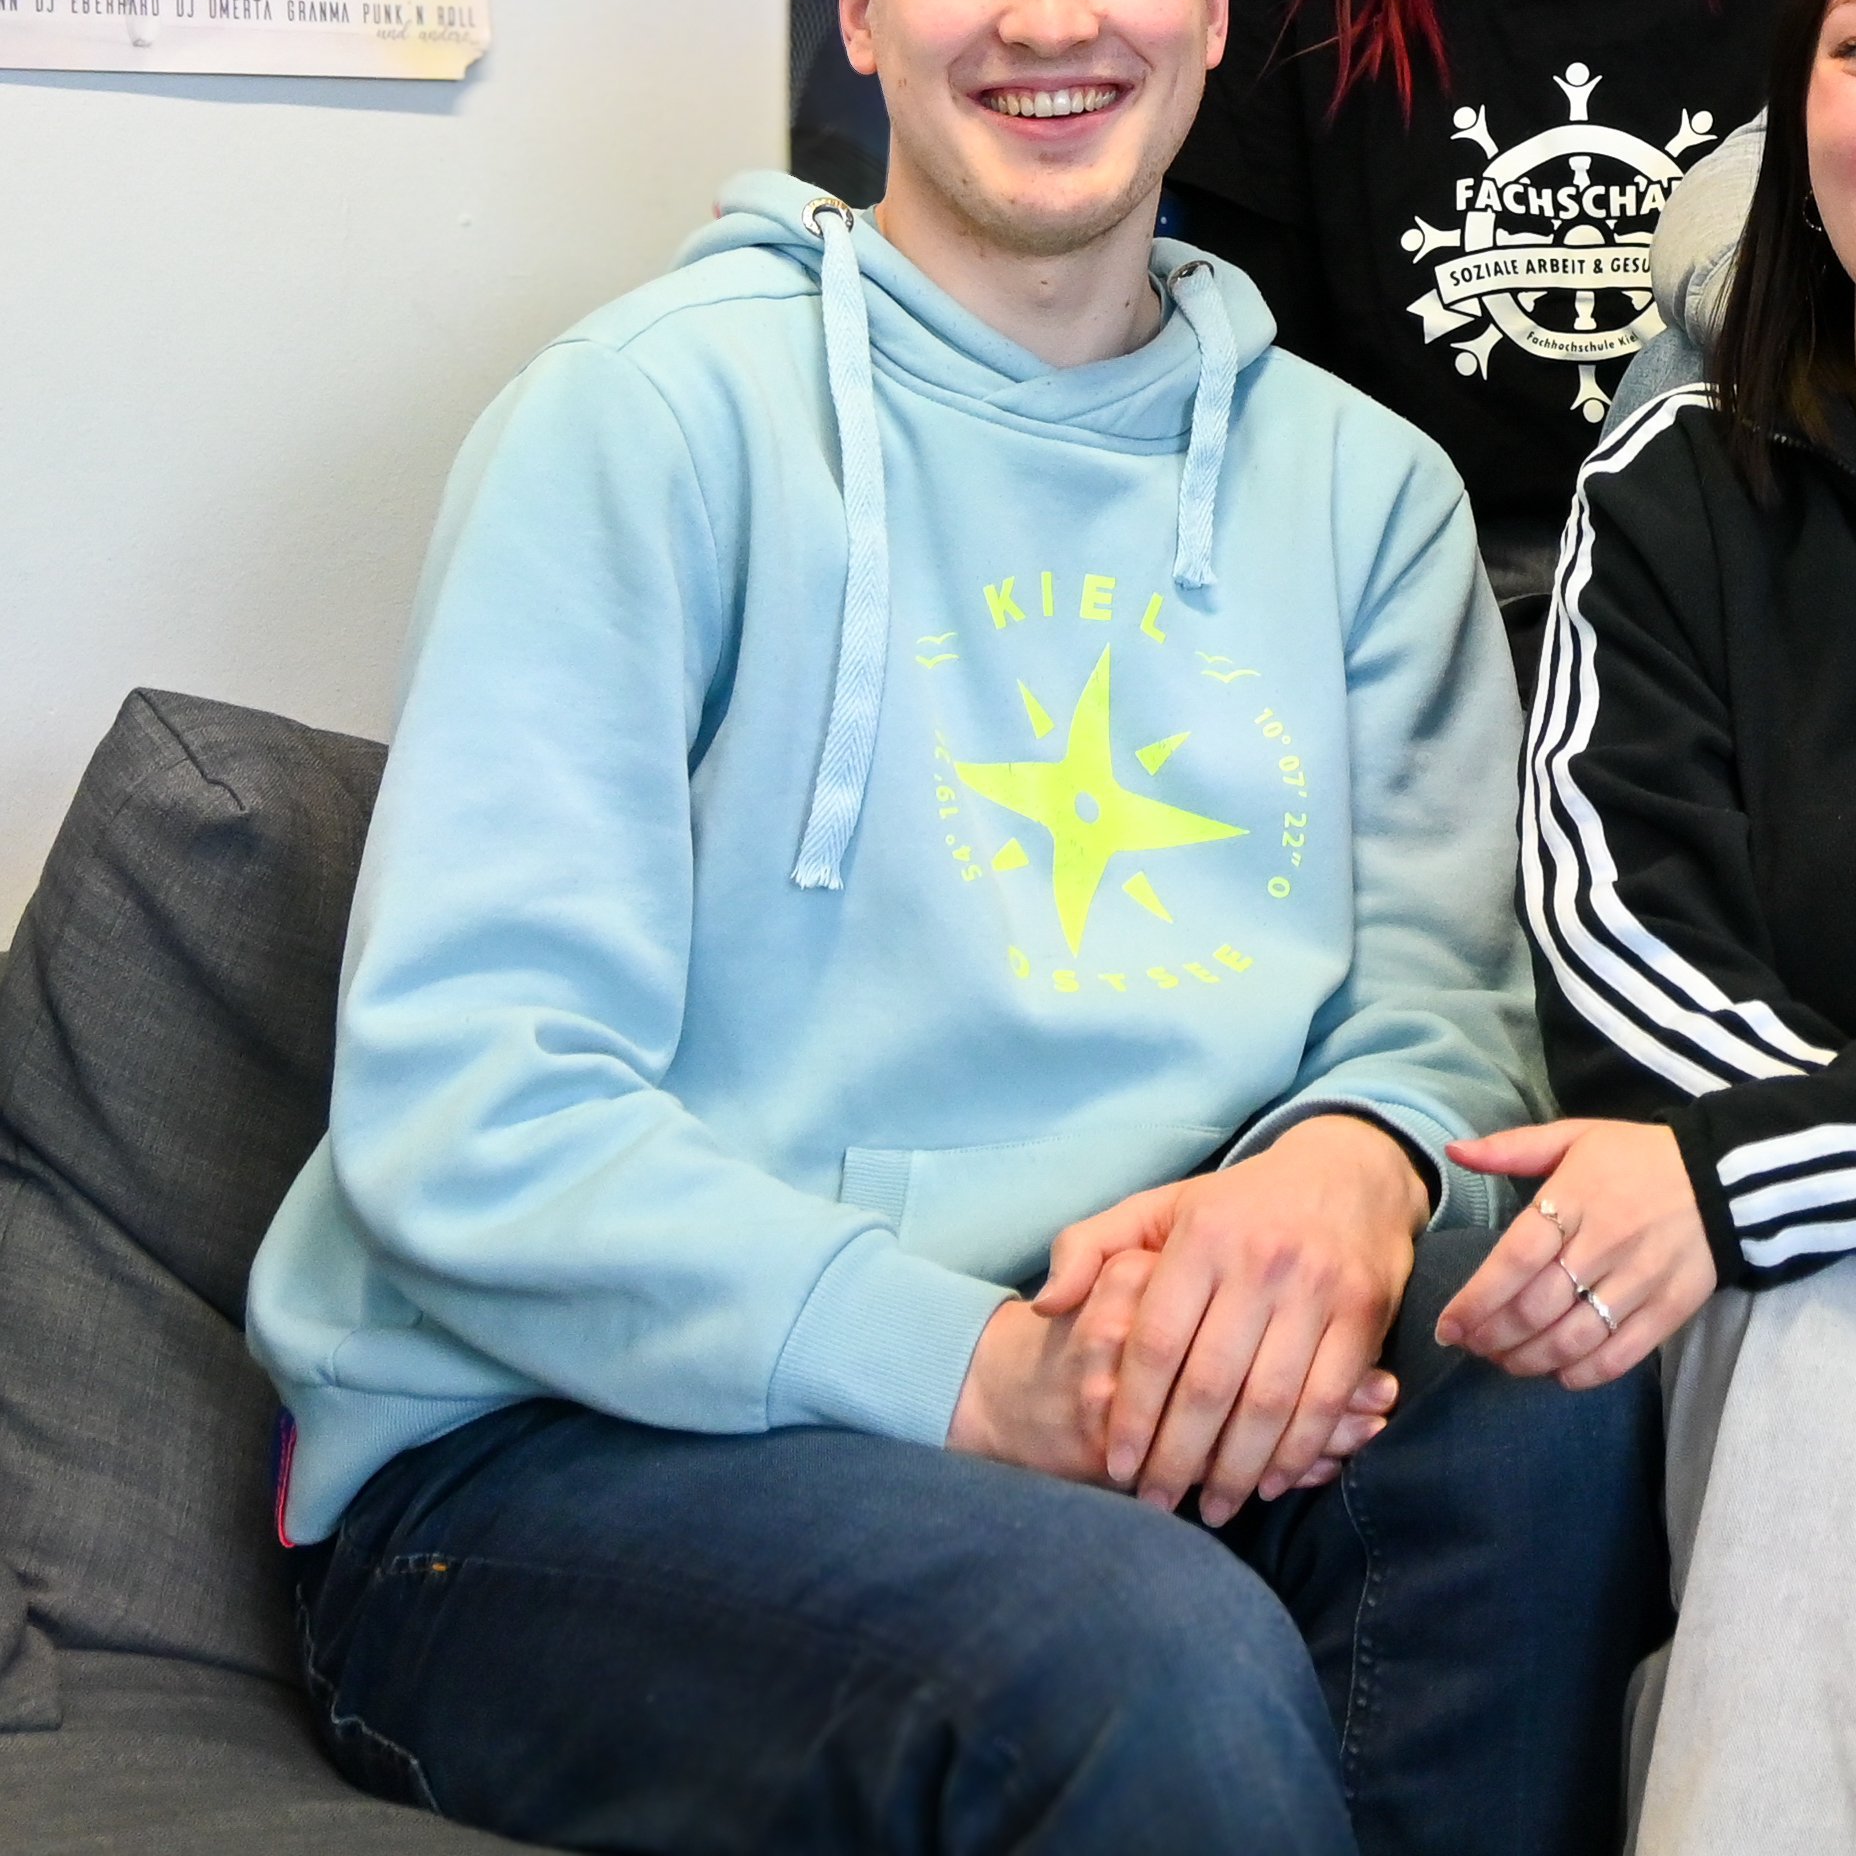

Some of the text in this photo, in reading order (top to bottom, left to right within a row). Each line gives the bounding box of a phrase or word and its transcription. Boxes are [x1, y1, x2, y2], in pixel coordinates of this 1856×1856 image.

[287, 0, 350, 24] GRANMA
[362, 2, 403, 26] PUNK
[436, 5, 477, 29] ROLL
[1449, 257, 1605, 288] SOZIALE ARBEIT &
[1525, 330, 1617, 354] Fachhochschule
[981, 569, 1168, 646] KIEL
